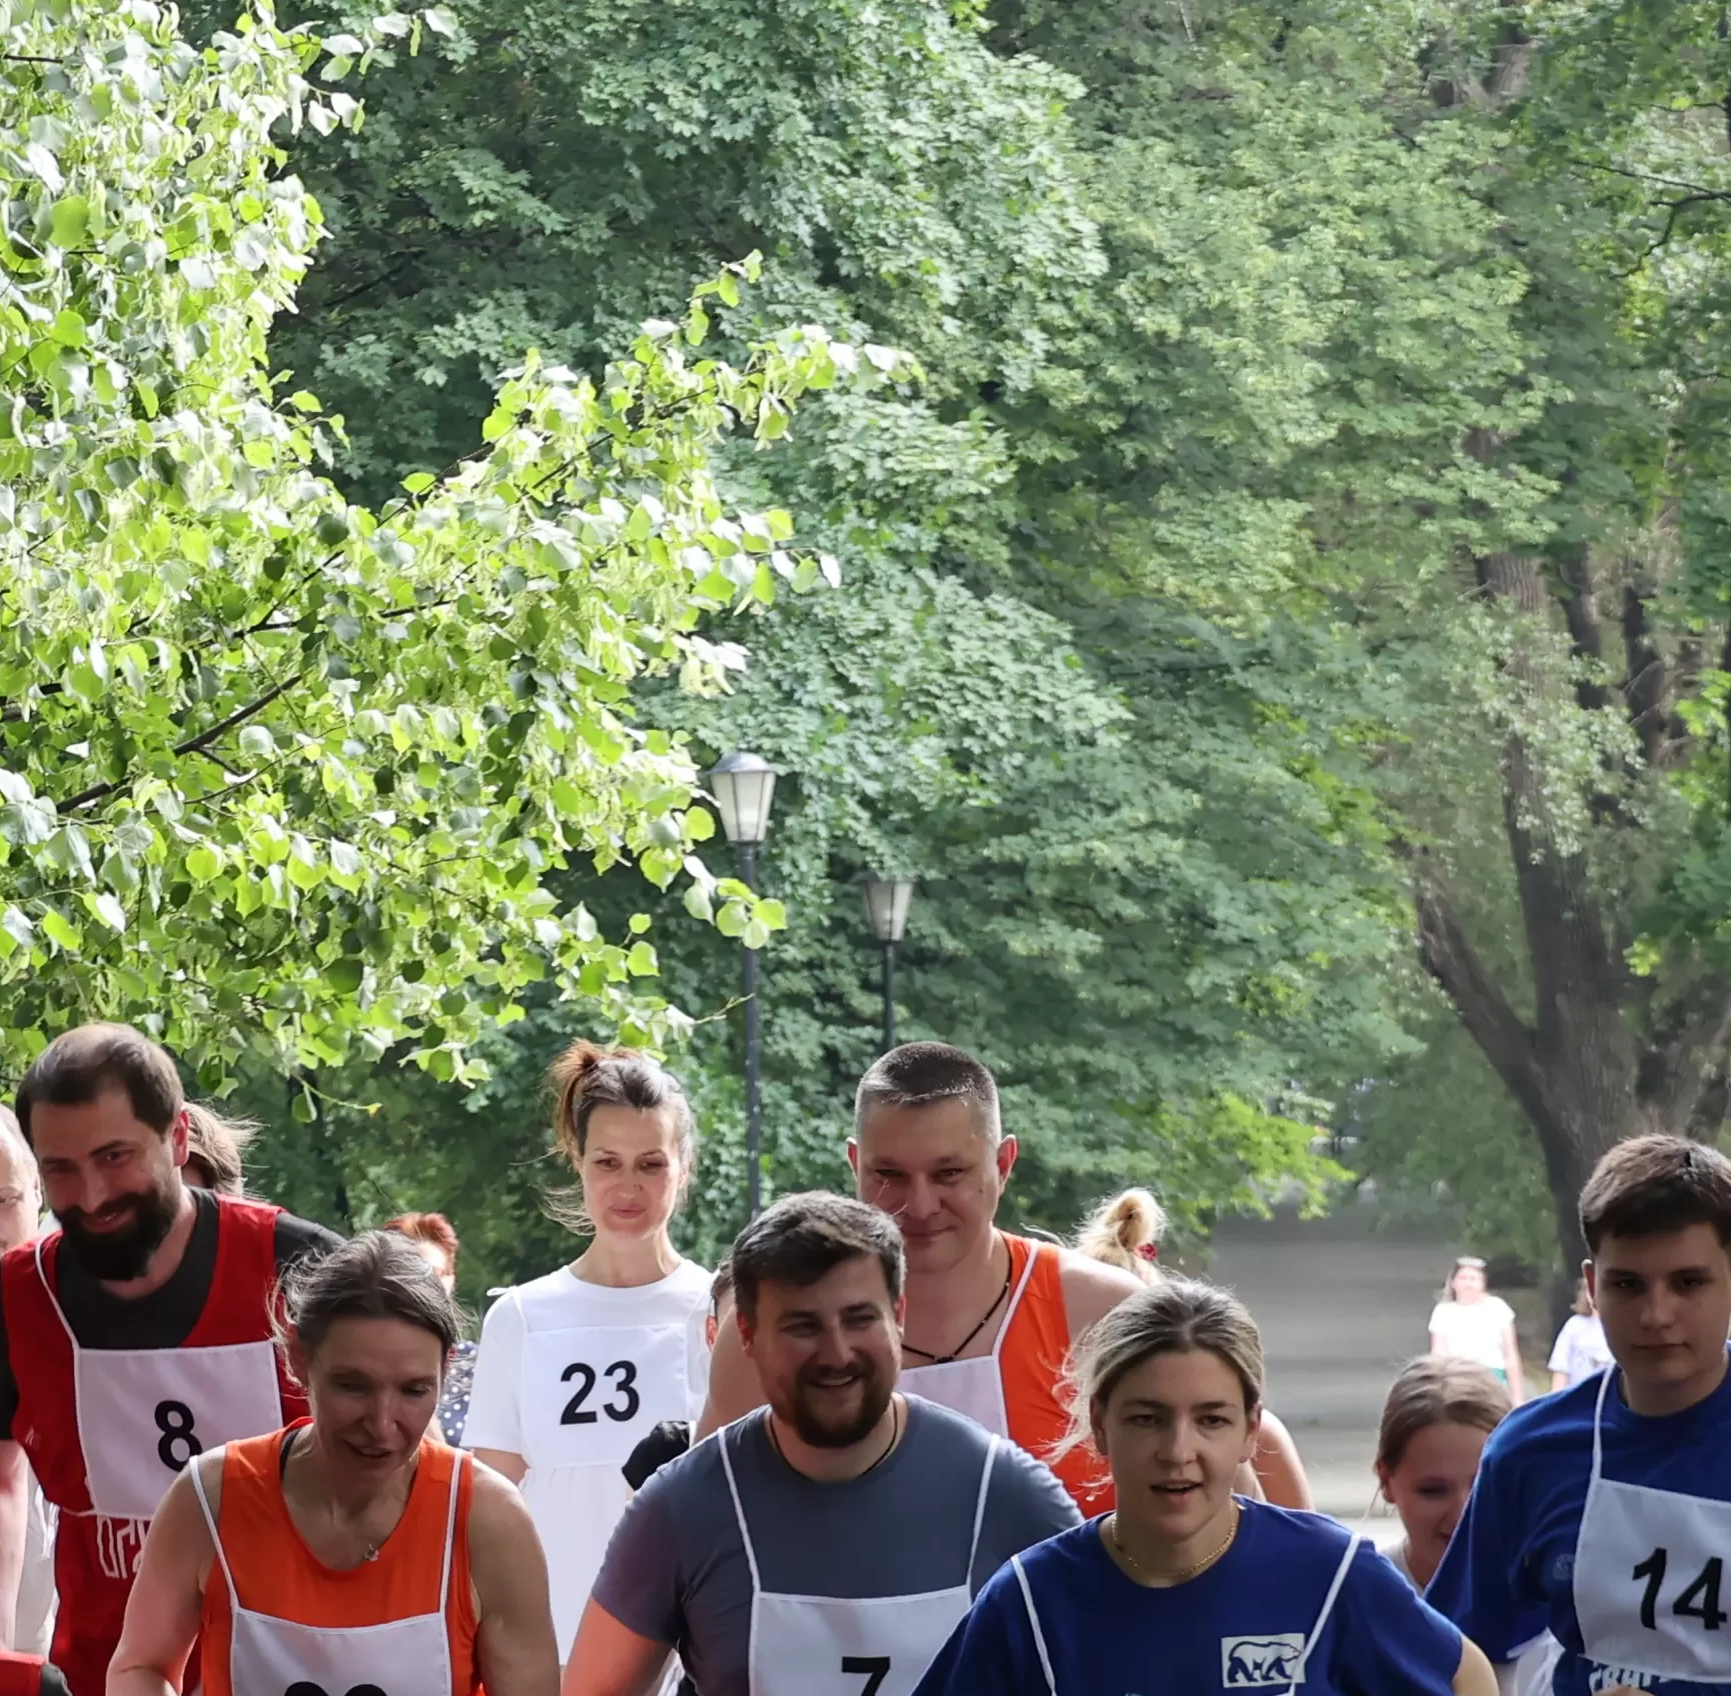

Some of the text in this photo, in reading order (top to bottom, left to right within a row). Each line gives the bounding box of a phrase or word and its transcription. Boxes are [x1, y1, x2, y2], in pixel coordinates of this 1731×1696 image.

[560, 1360, 640, 1425] 23
[154, 1400, 203, 1473] 8
[1631, 1547, 1730, 1632] 14
